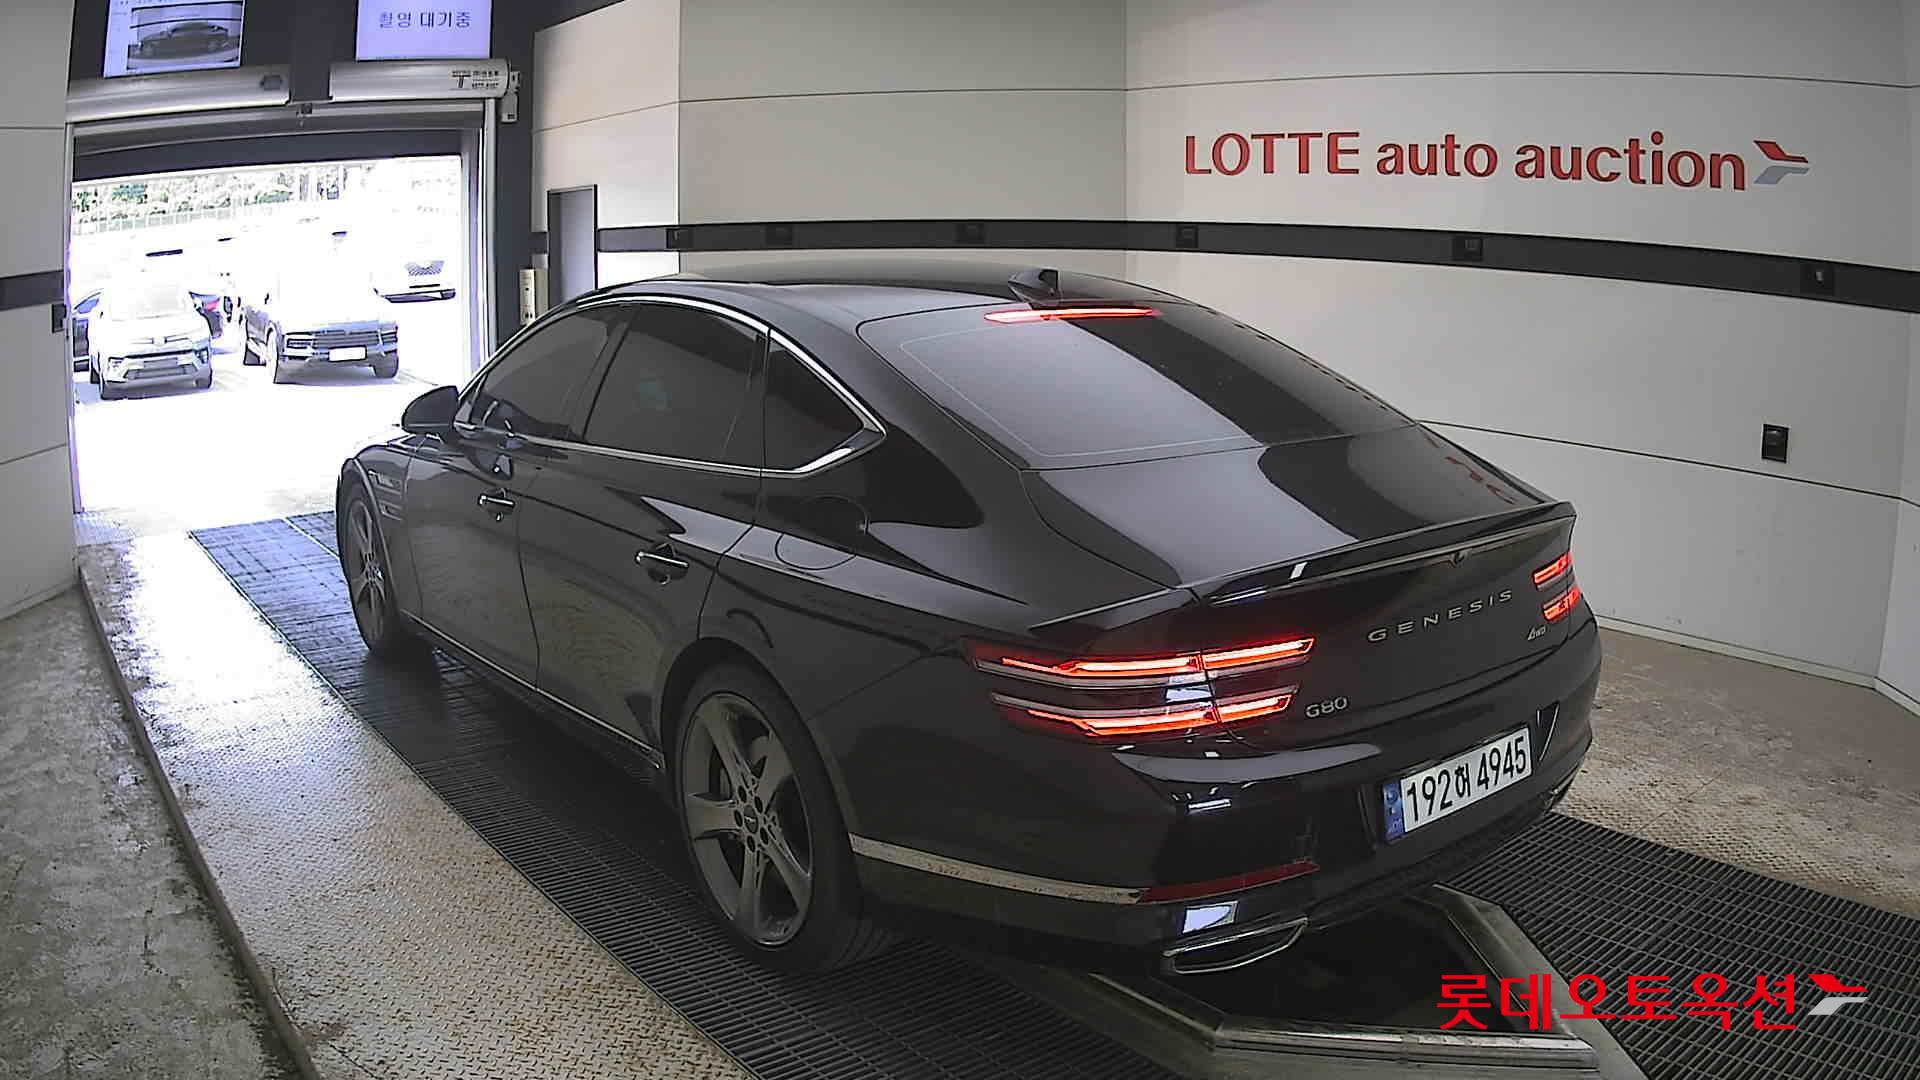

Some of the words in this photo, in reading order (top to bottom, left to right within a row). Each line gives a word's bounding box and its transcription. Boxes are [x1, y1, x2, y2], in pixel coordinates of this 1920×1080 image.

[420, 11, 472, 29] 대기중
[1184, 132, 1360, 176] LOTTE
[1376, 134, 1498, 177] auto
[1516, 132, 1745, 190] auction
[1367, 590, 1513, 642] GENESIS
[1305, 696, 1349, 719] G80
[1407, 763, 1471, 822] 192허
[1477, 736, 1527, 790] 4945
